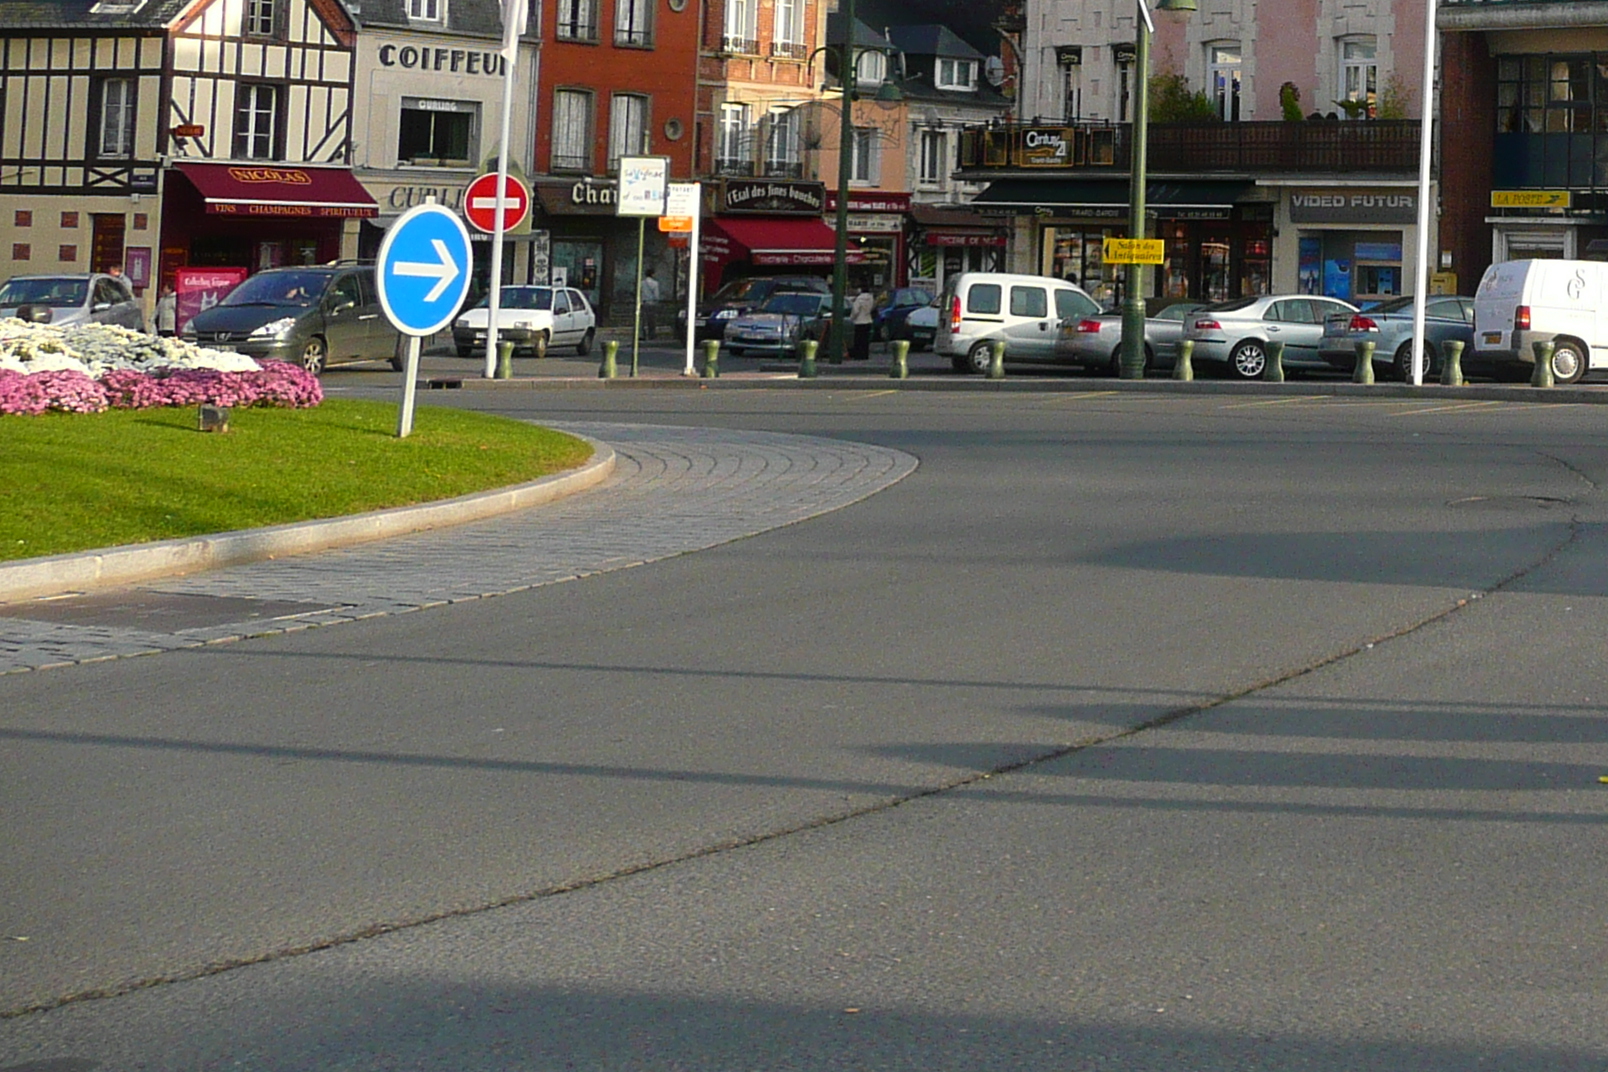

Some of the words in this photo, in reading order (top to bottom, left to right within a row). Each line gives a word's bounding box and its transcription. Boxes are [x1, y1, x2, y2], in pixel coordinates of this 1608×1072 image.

[1026, 131, 1060, 147] Century
[1055, 141, 1067, 156] 21
[235, 169, 306, 182] NICOLAS
[751, 185, 766, 197] des
[768, 184, 788, 197] fines
[789, 185, 820, 208] bouches
[1292, 195, 1345, 207] VIDEO
[1351, 195, 1413, 207] FUTUR
[1496, 195, 1509, 204] LA
[1513, 194, 1543, 205] POSTE
[215, 204, 236, 213] VINS
[249, 205, 311, 216] CHAMPAGNES
[320, 207, 373, 217] SPIRITUEUX
